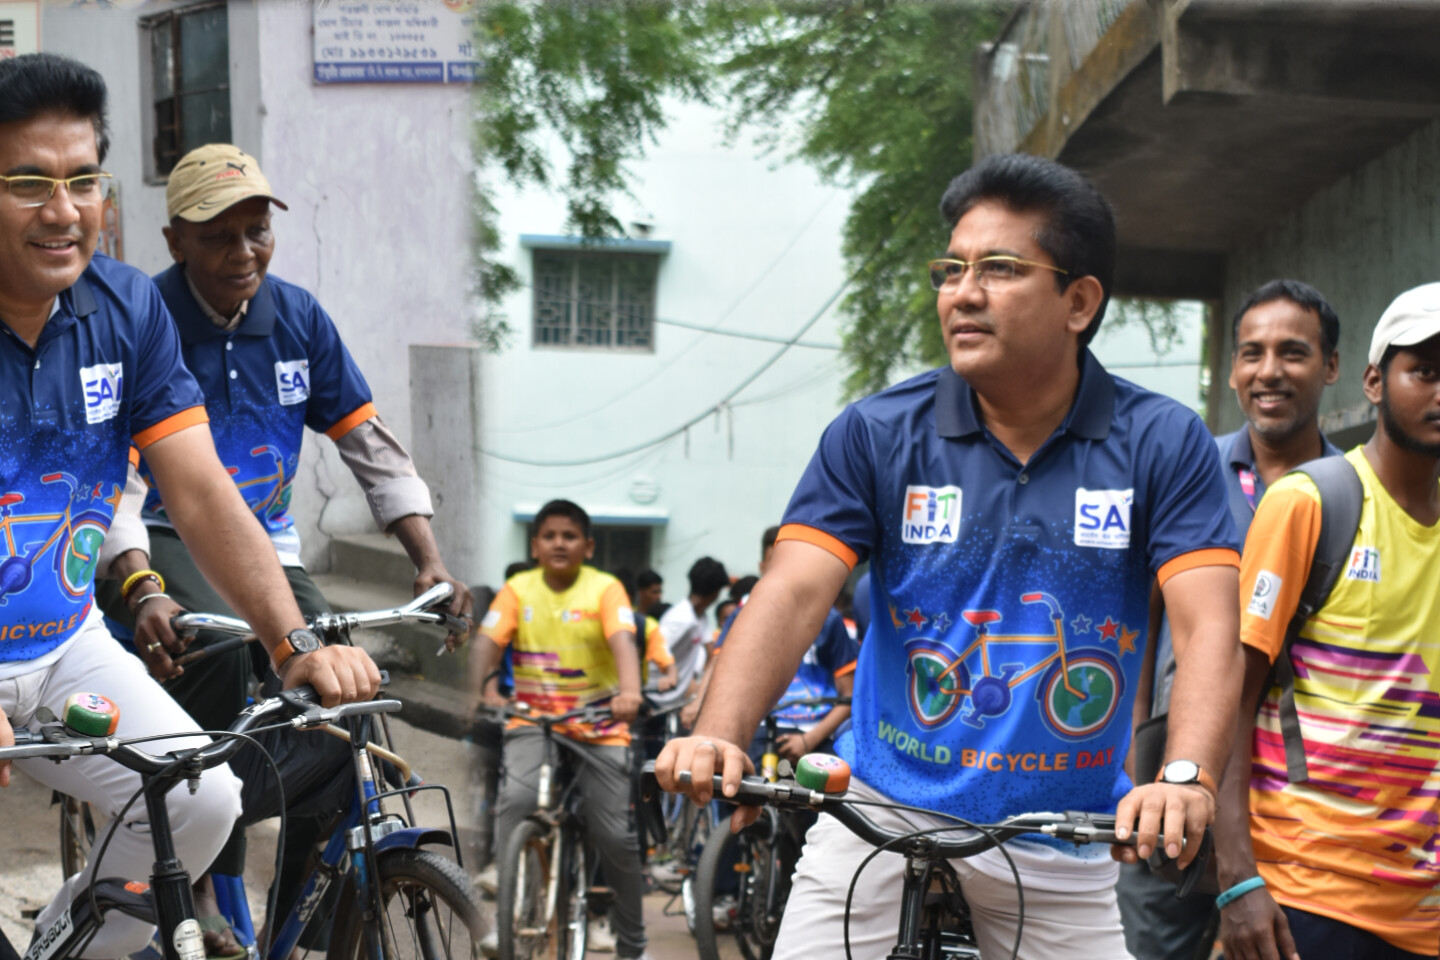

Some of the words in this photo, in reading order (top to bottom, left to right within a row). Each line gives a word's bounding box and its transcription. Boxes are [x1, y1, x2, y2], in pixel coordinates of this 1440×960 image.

[85, 377, 124, 409] SAI
[906, 489, 957, 523] FIT
[1348, 567, 1379, 582] INDIA
[1351, 548, 1378, 570] FIT
[877, 720, 952, 765] WORLD
[961, 748, 1069, 772] BICYCLE
[1075, 745, 1115, 770] DAY
[31, 907, 72, 960] SKYBOLT
